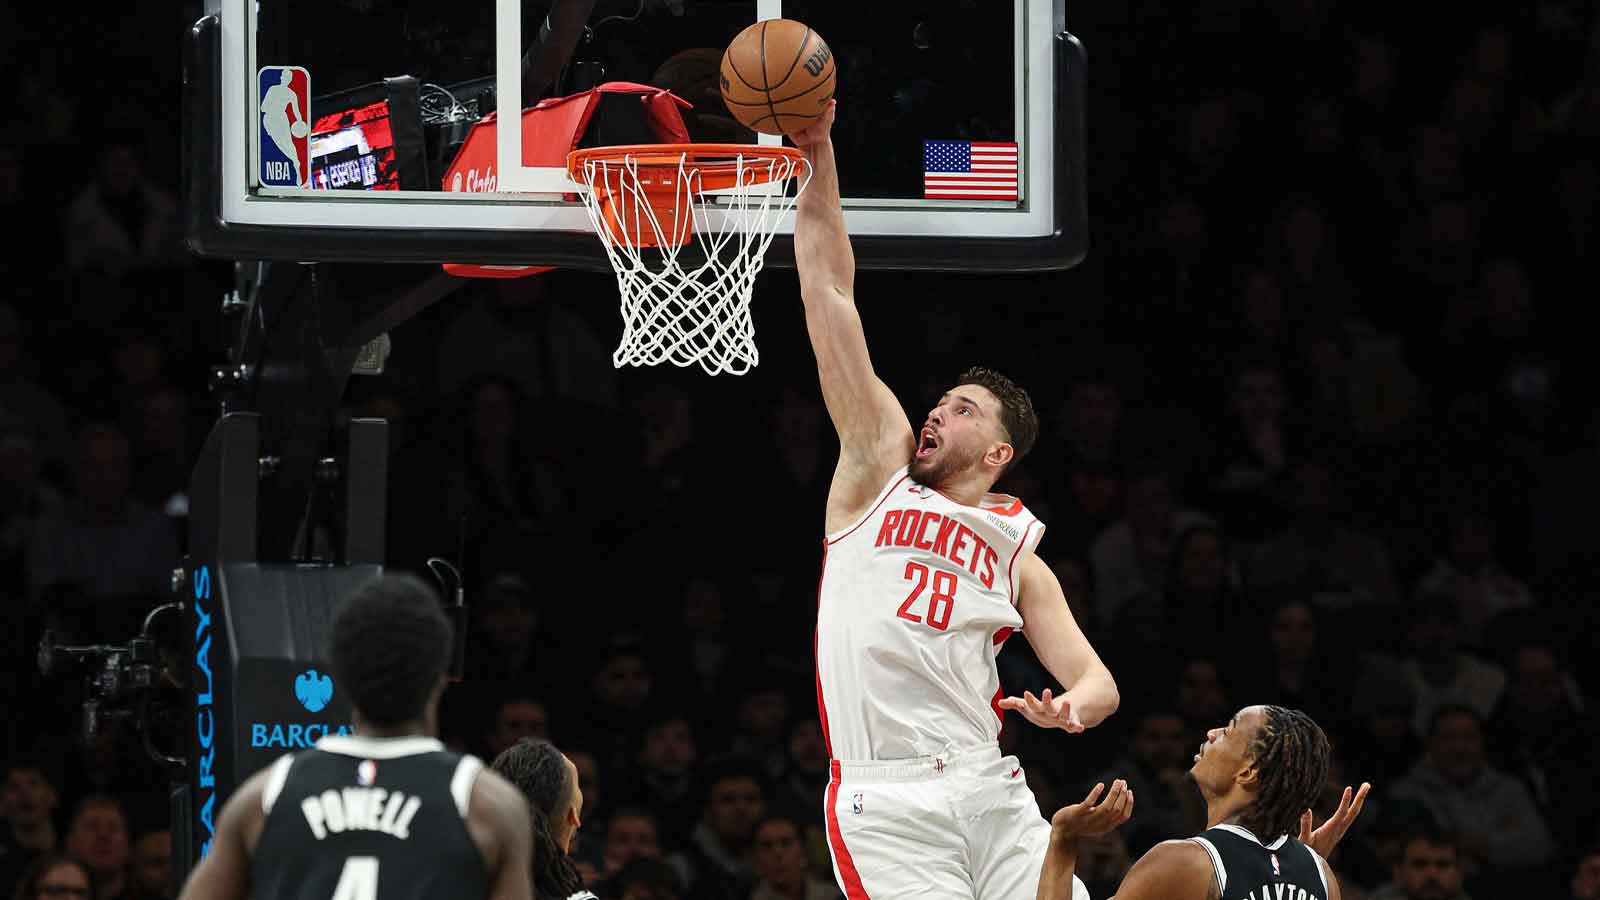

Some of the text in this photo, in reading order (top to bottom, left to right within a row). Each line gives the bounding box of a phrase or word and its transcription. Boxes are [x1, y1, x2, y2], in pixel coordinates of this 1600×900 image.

[265, 160, 291, 181] NBA
[874, 508, 999, 591] ROCKETS
[896, 560, 958, 633] 28
[250, 723, 355, 748] BARCLA
[301, 786, 422, 840] POWELL
